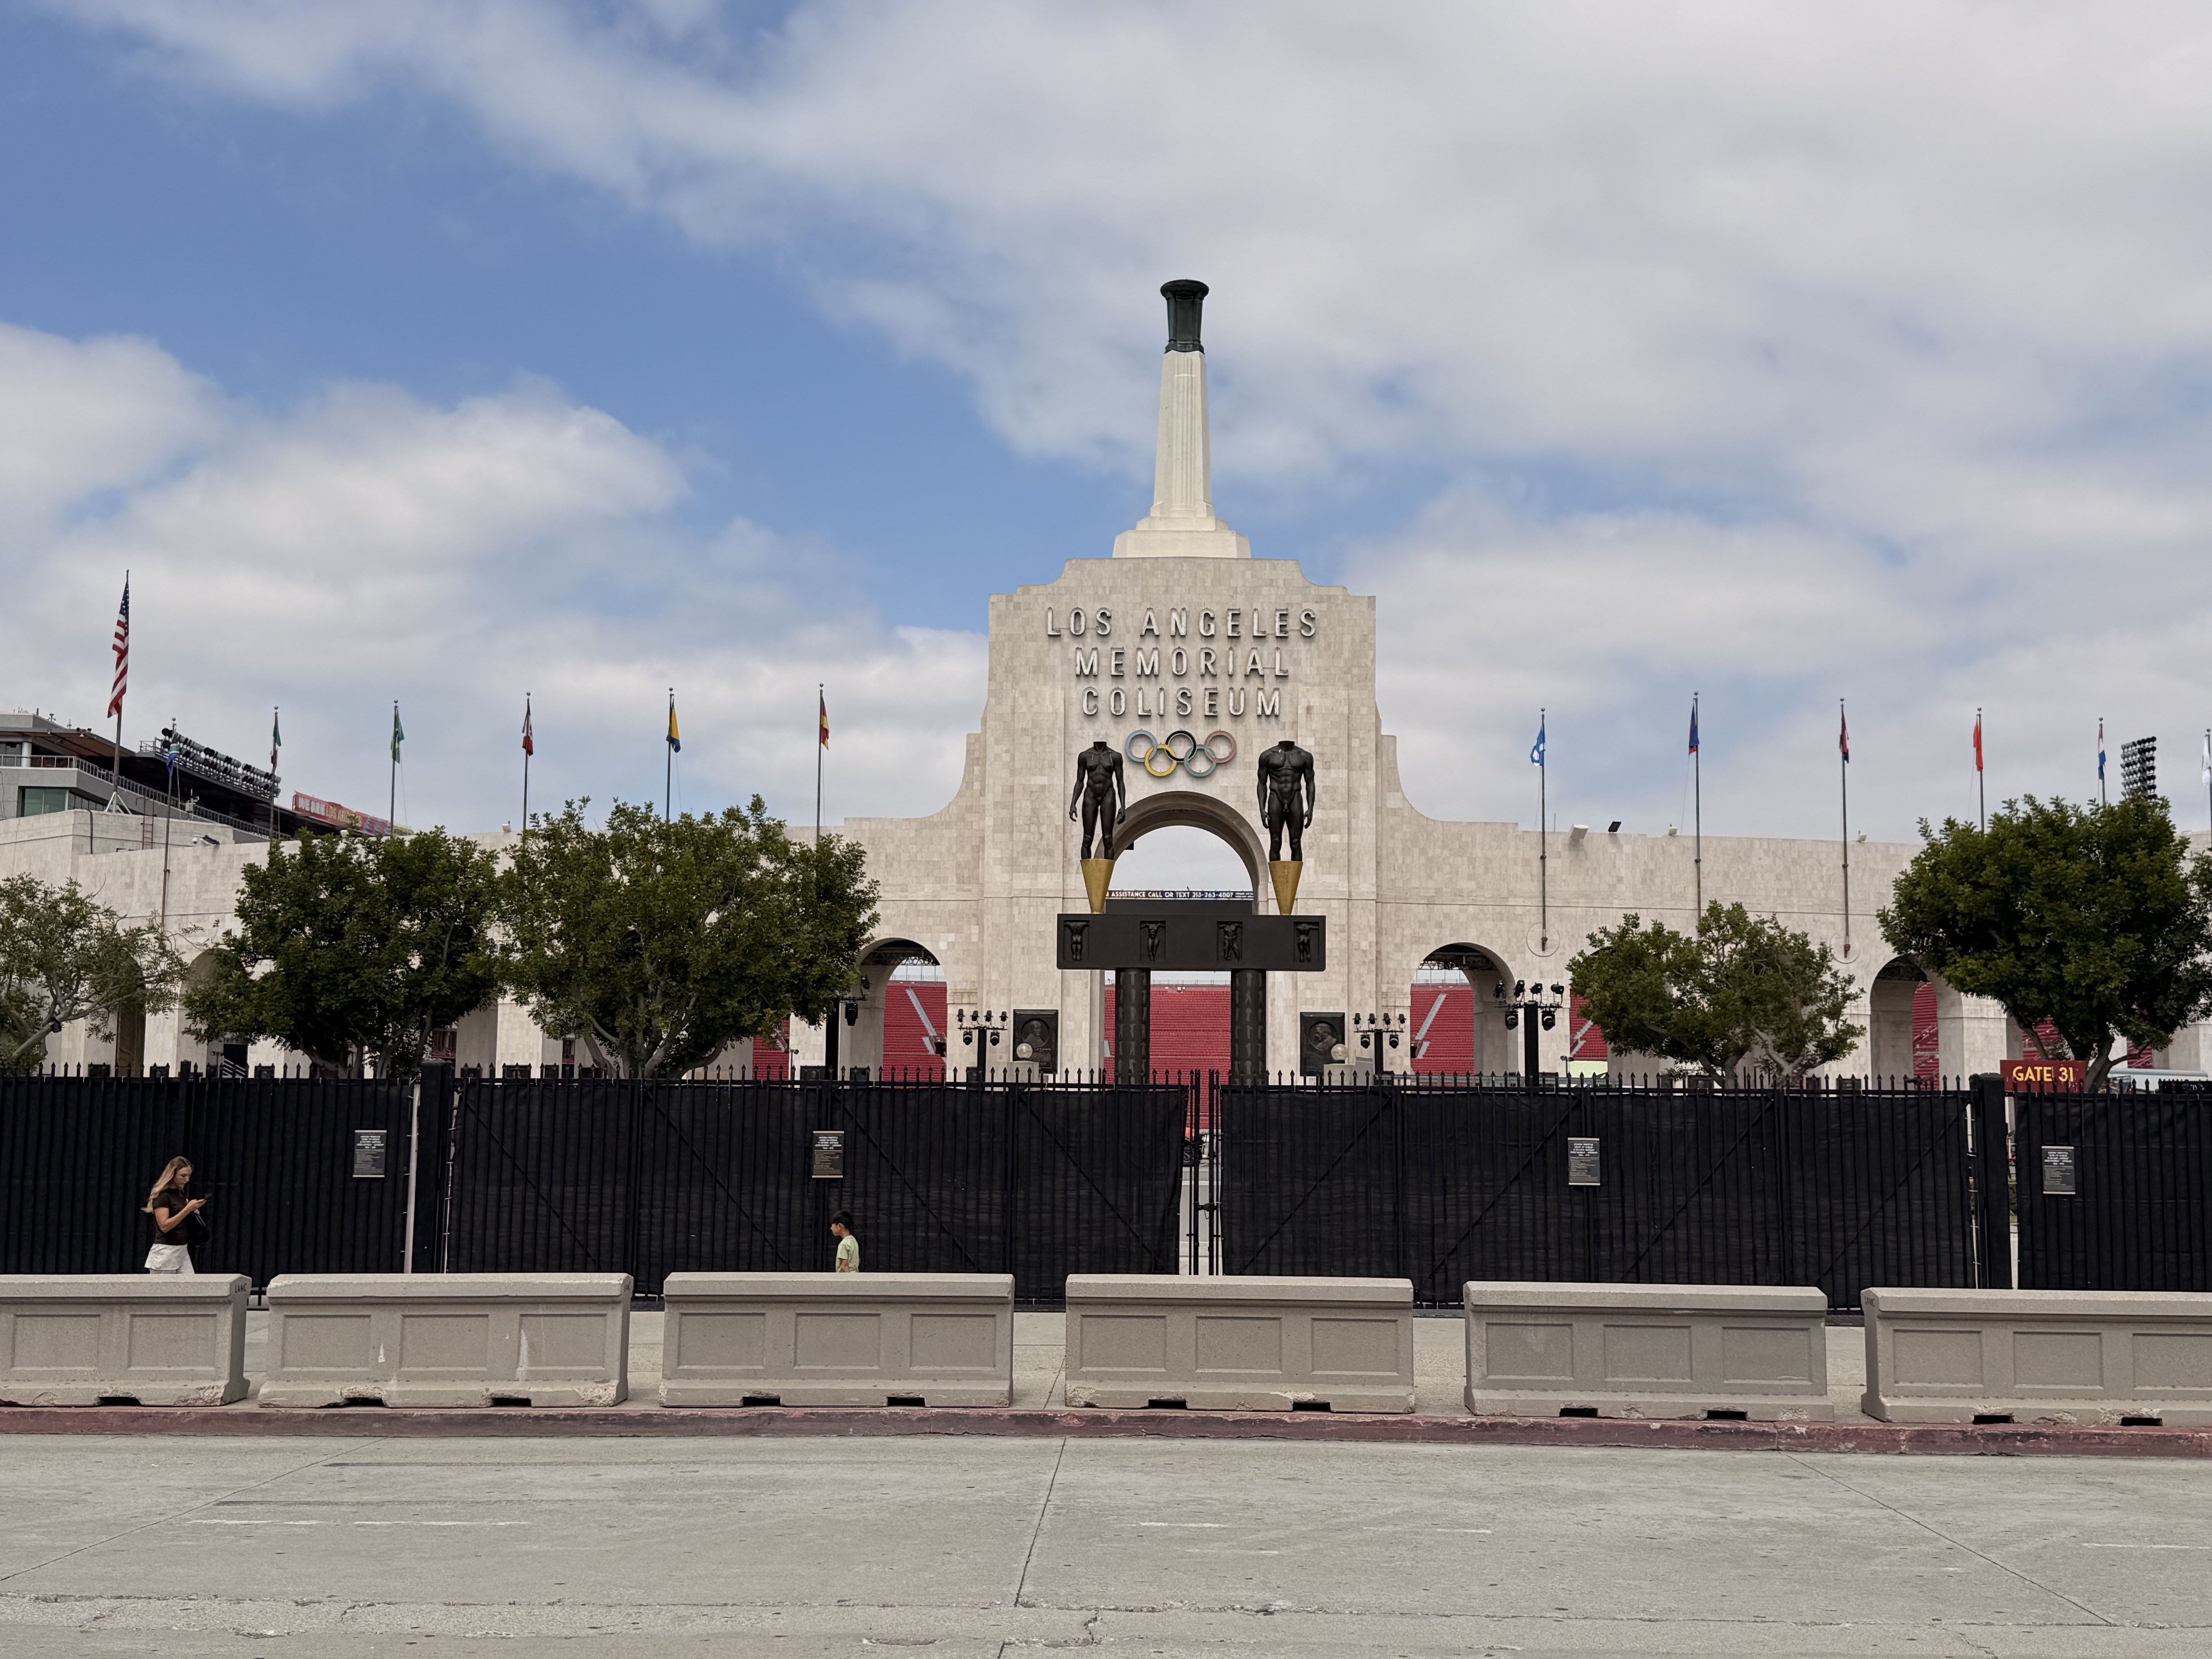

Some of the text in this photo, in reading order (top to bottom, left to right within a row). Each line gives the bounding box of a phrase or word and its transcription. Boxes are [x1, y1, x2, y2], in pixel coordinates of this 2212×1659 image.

[1047, 607, 1316, 637] LOS ANGELES
[1075, 647, 1288, 676] MEMORIAL
[1083, 687, 1279, 716] COLISEUM
[2013, 1066, 2074, 1082] GATE 31
